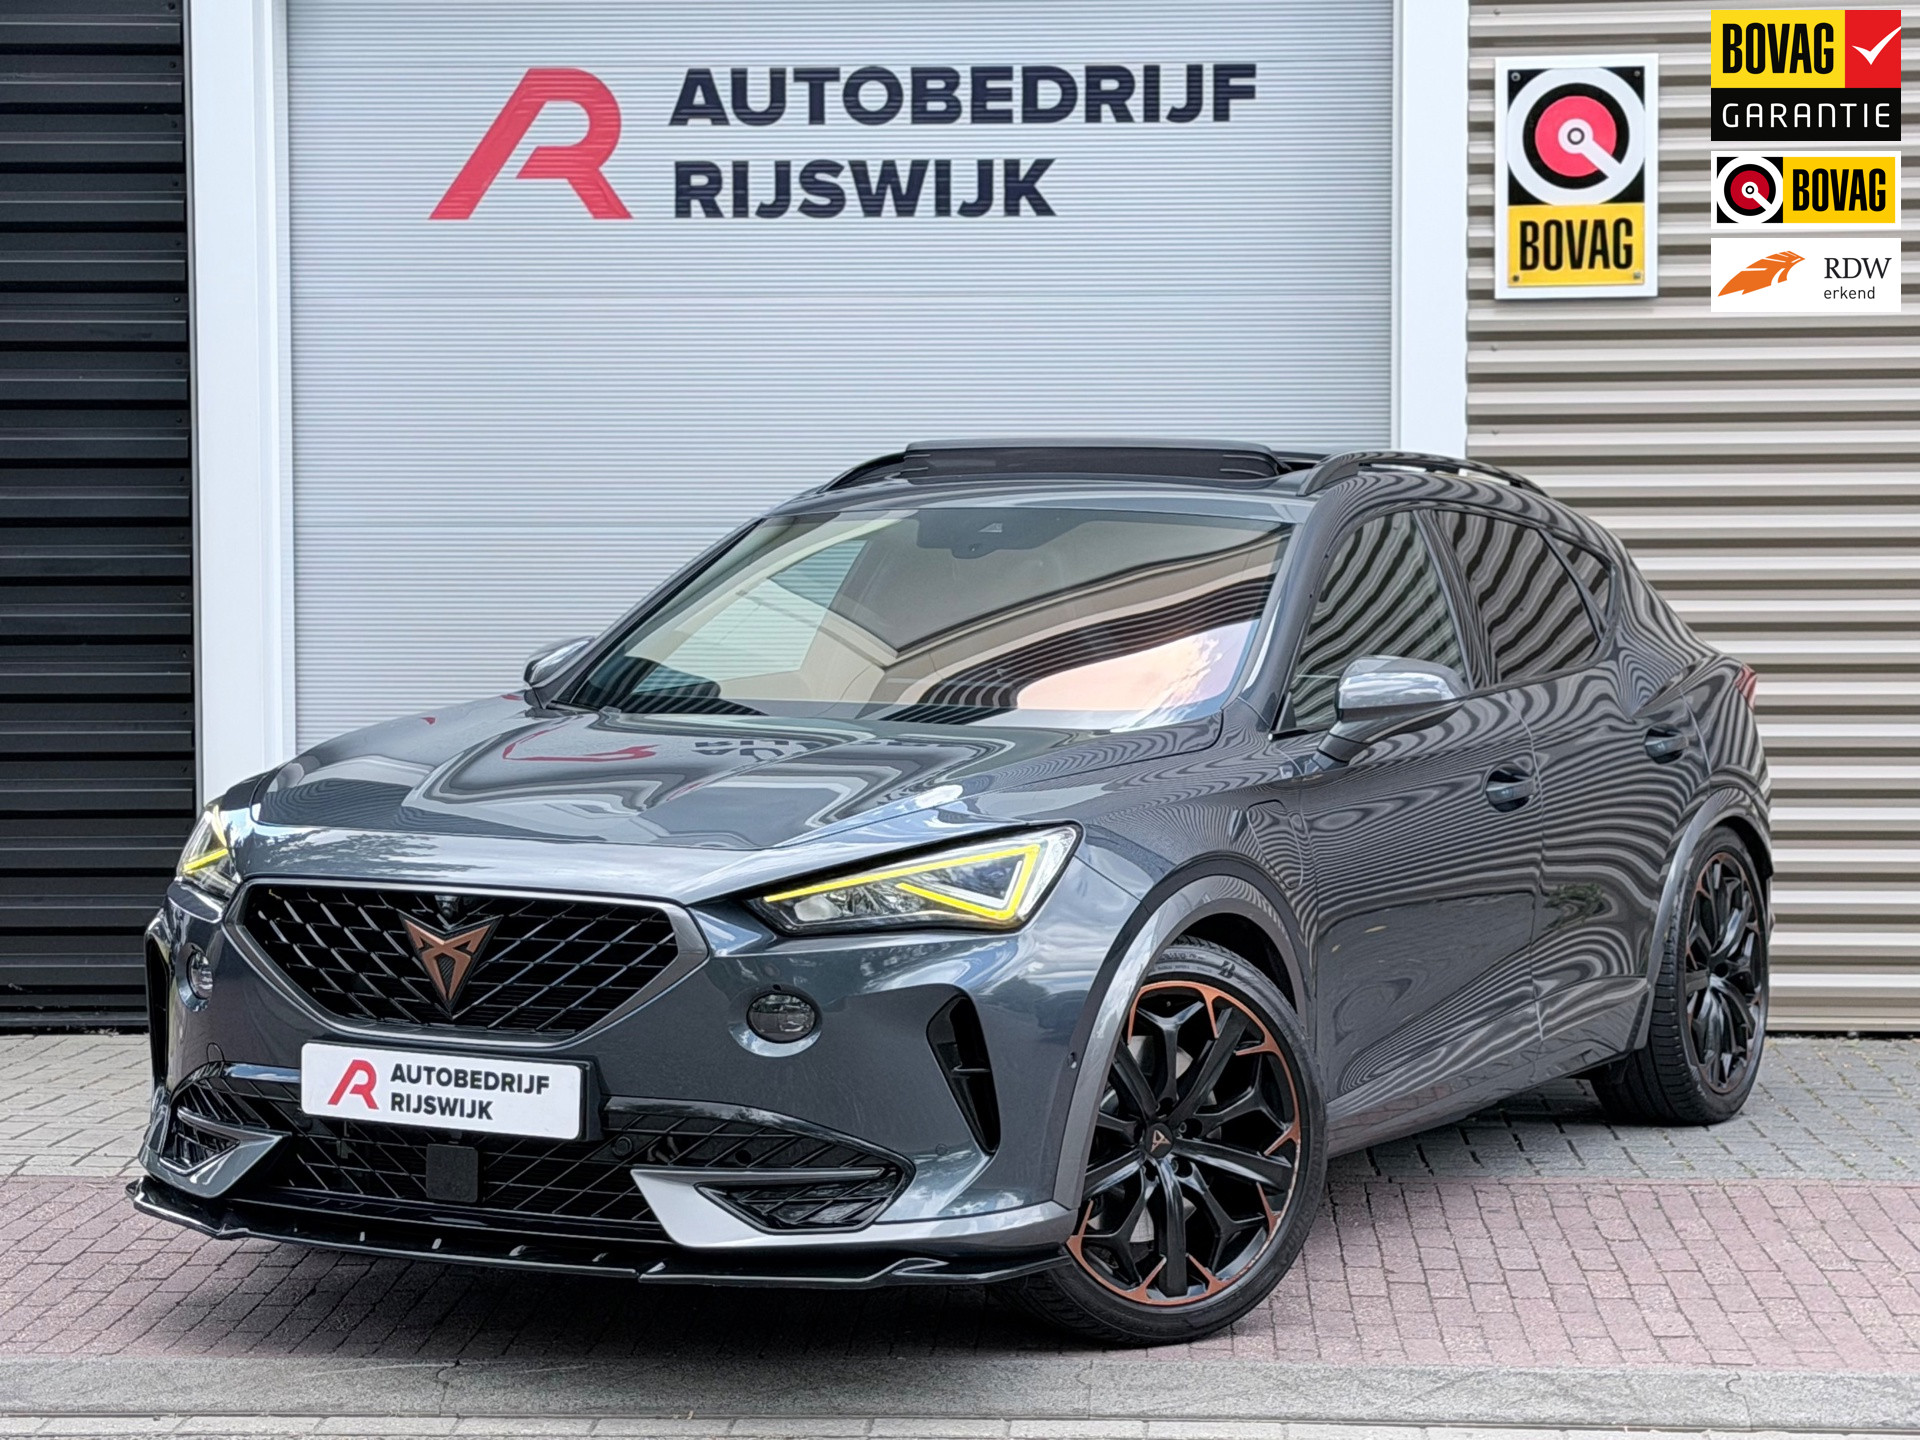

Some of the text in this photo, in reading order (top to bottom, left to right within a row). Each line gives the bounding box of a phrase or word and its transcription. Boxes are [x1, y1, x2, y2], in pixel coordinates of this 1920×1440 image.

[668, 64, 1258, 126] AUTOBEDRIJF
[673, 158, 1057, 218] RIJSWIJK
[1519, 217, 1634, 271] BOVAG
[390, 1063, 550, 1095] AUTOBEDRIJF
[390, 1092, 493, 1120] RIJSWIJK
